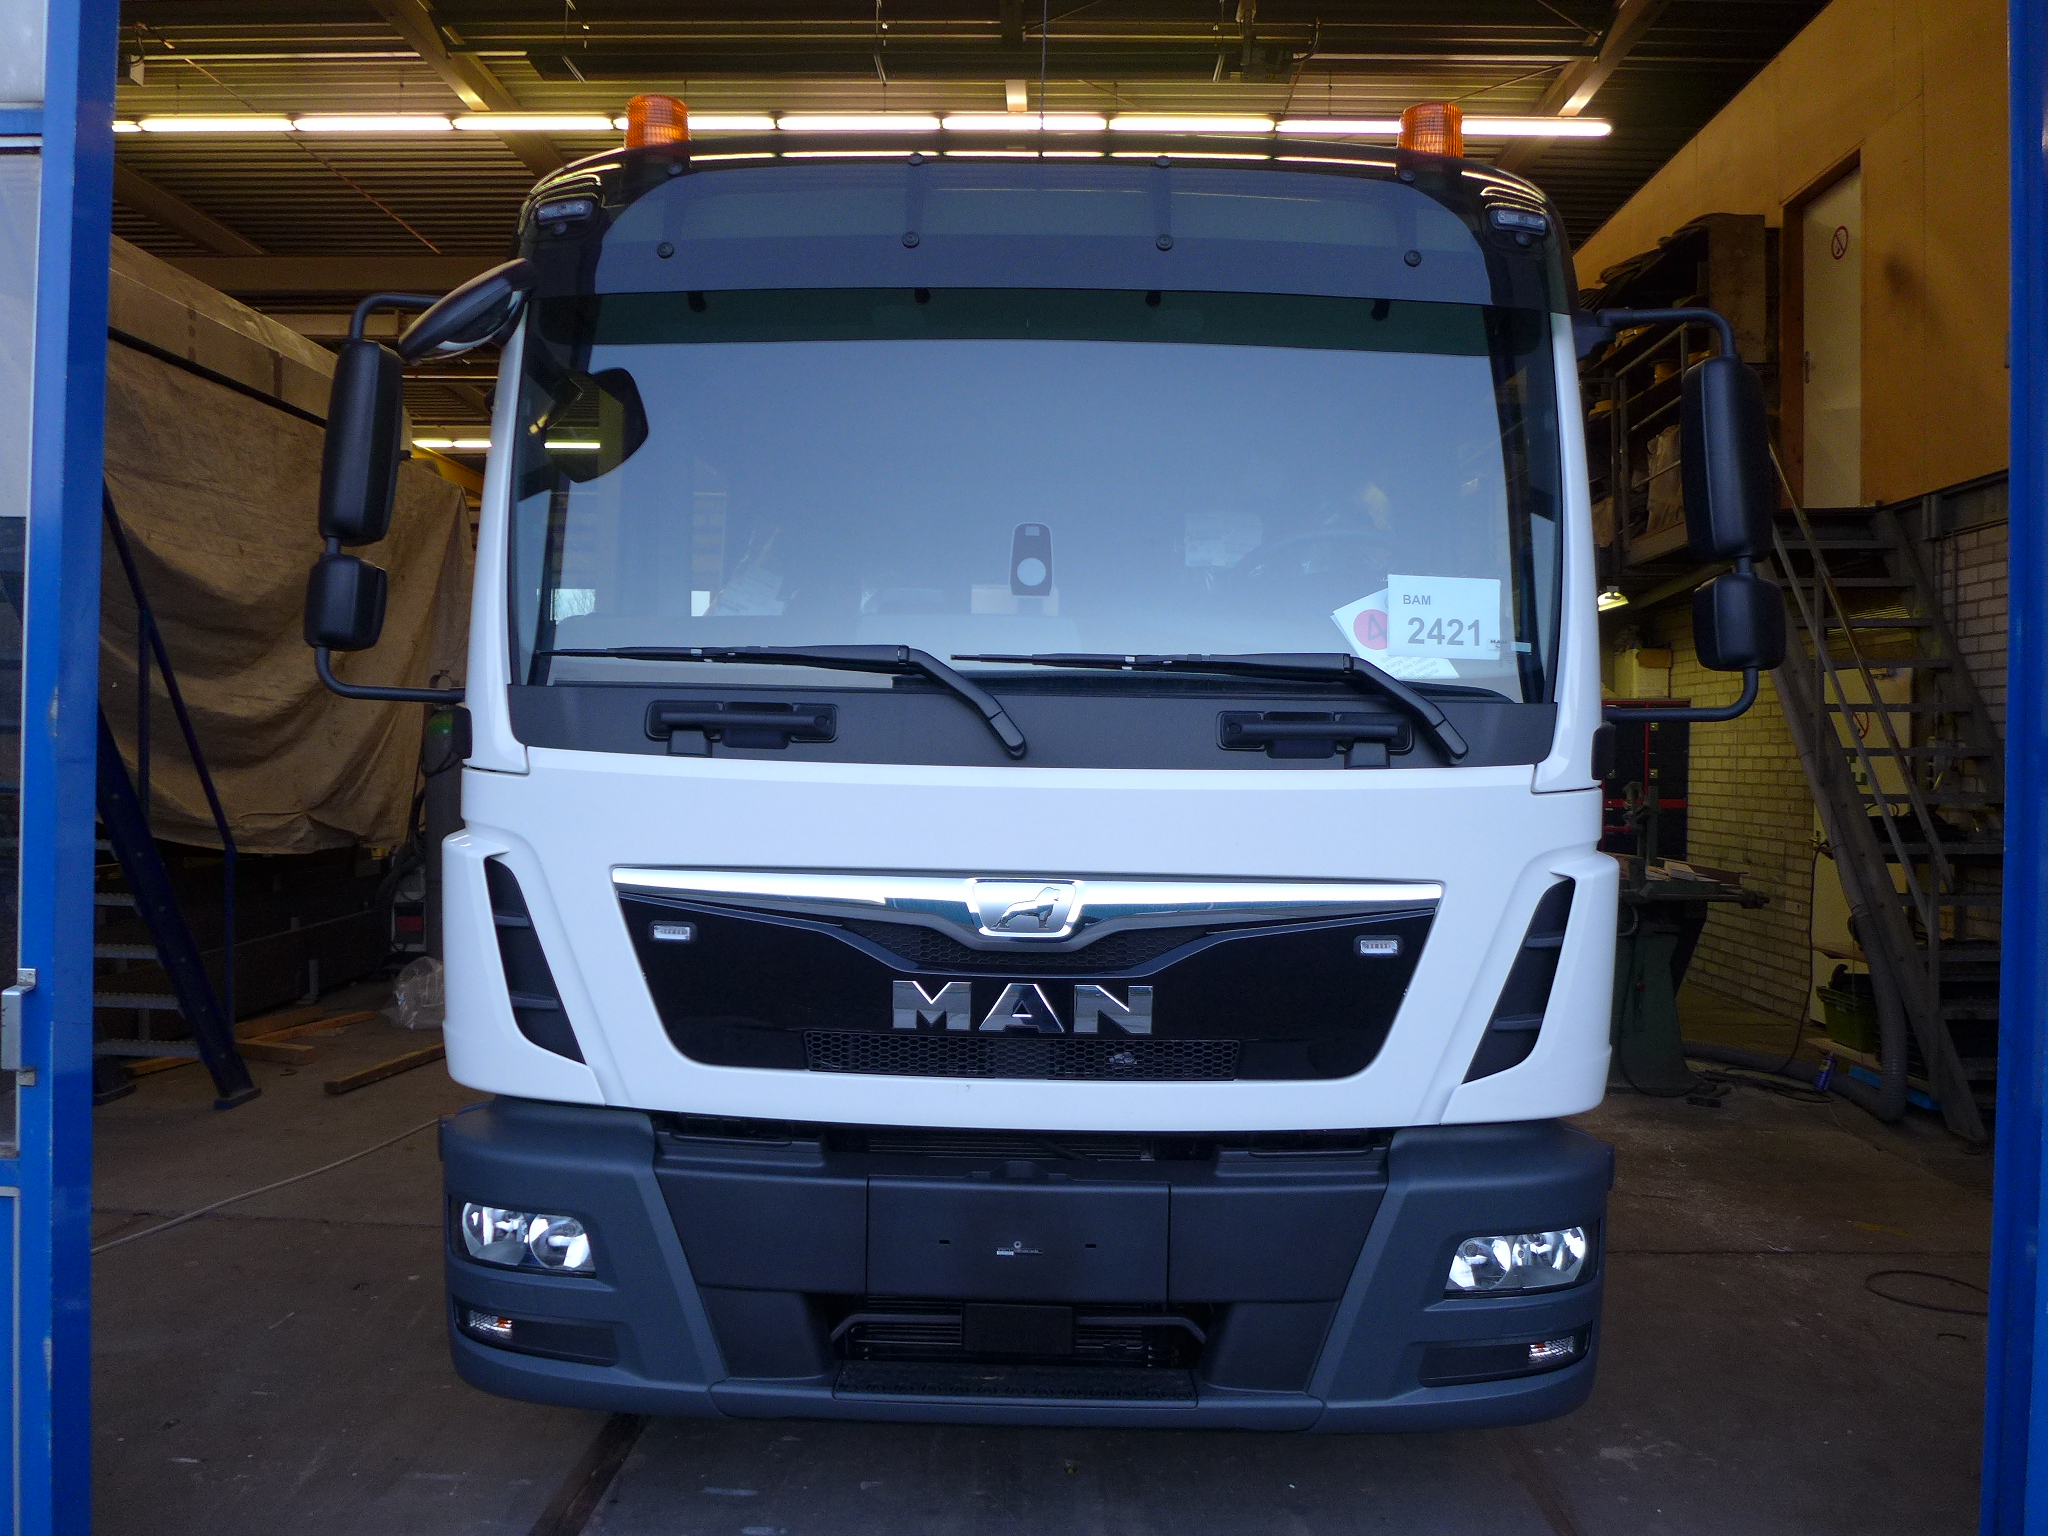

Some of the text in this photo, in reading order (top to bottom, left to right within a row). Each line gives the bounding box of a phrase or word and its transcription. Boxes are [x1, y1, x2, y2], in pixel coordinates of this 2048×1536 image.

[1403, 594, 1431, 605] BAM
[1407, 617, 1480, 646] 2421
[892, 980, 1154, 1035] MAN
